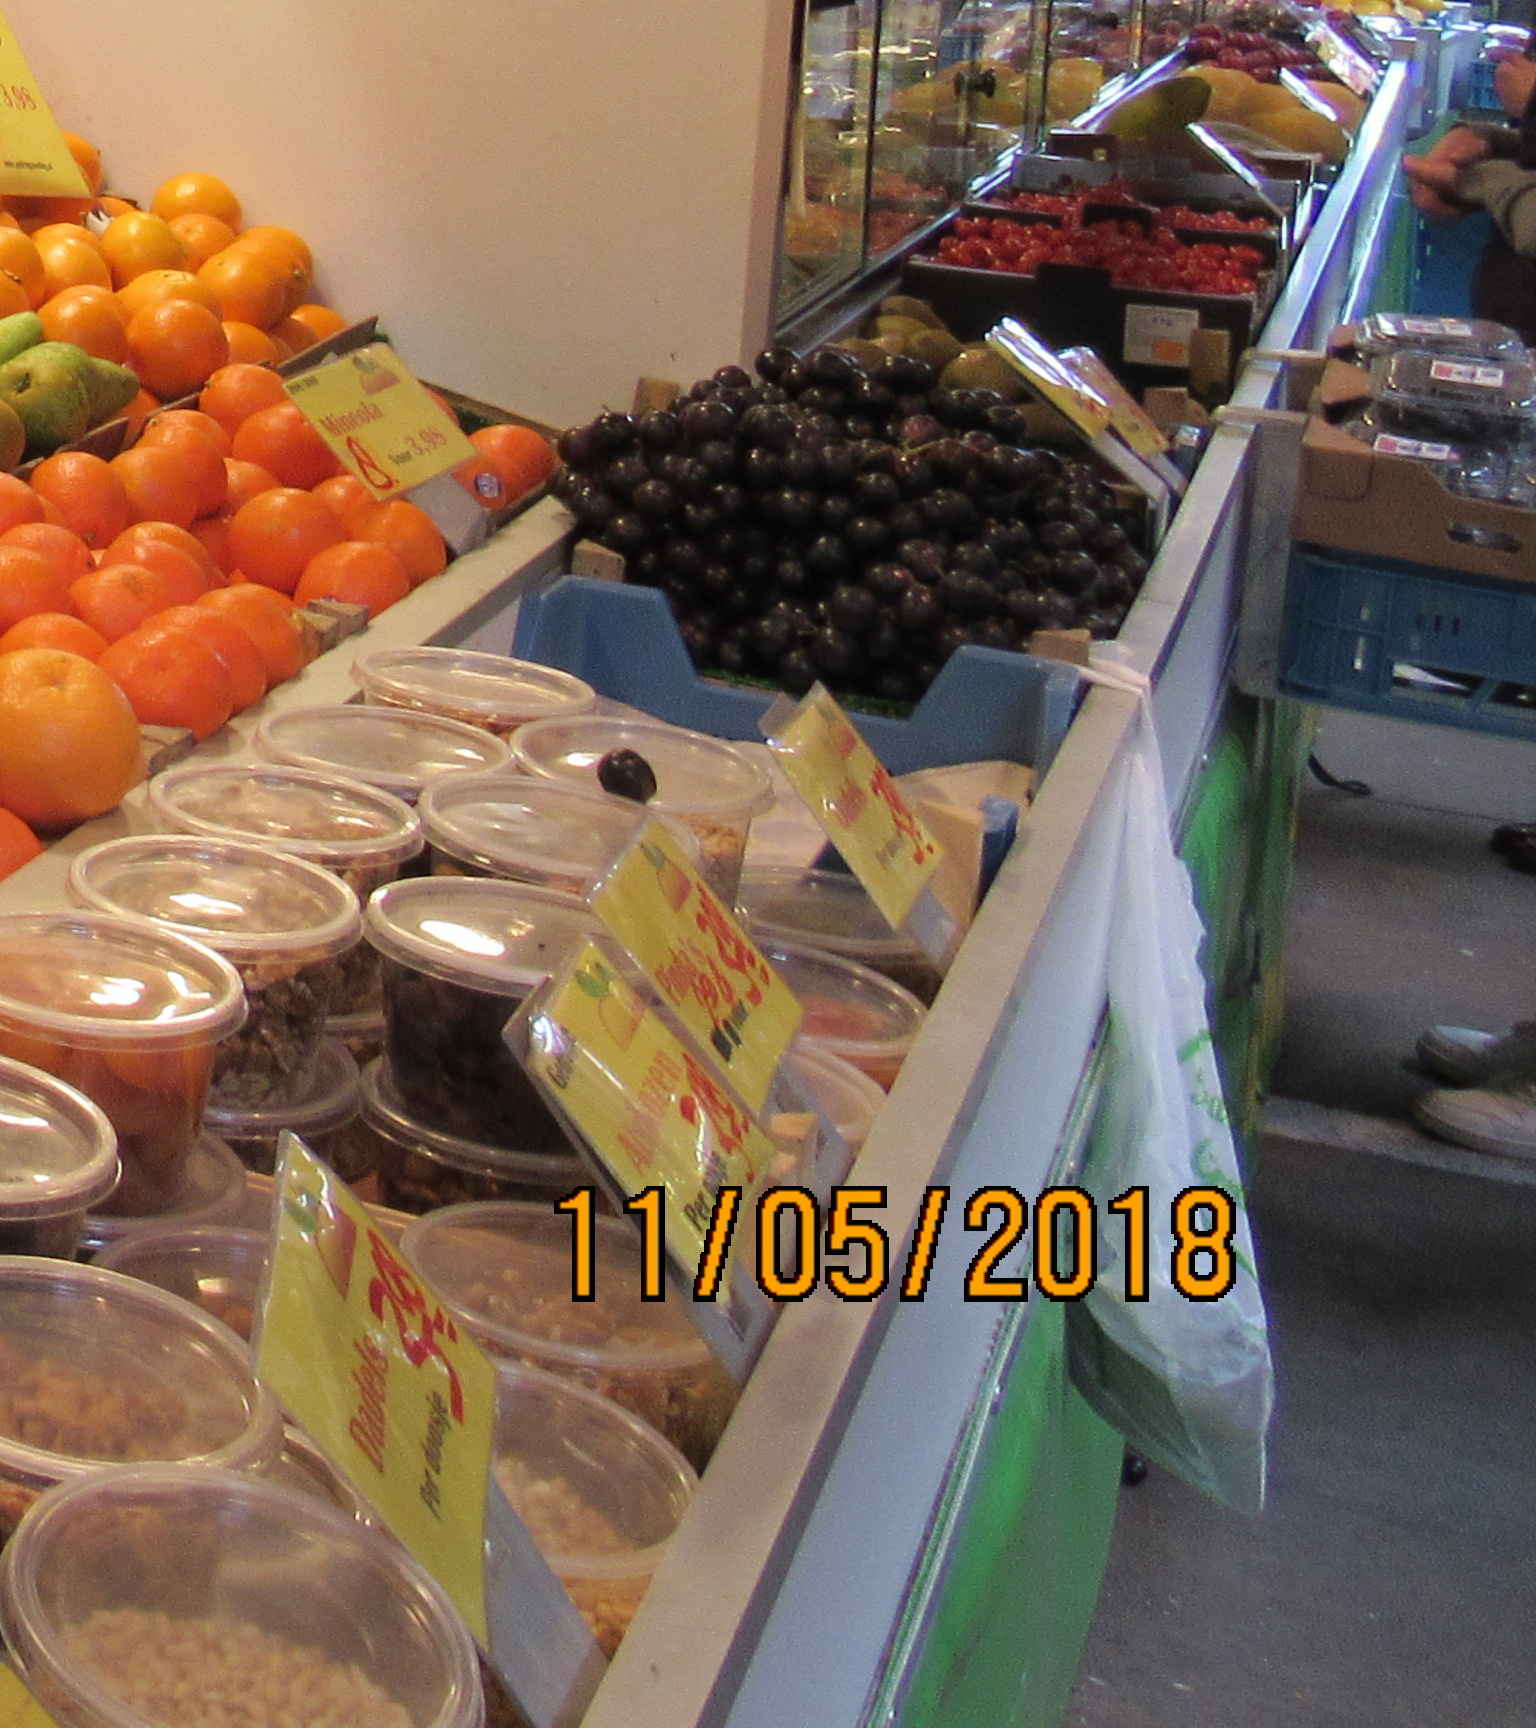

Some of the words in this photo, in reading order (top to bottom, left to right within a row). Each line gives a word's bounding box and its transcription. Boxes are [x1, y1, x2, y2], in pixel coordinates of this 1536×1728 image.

[2, 84, 38, 111] 3,98
[349, 1331, 391, 1475] Dadels
[420, 1468, 443, 1522] Per
